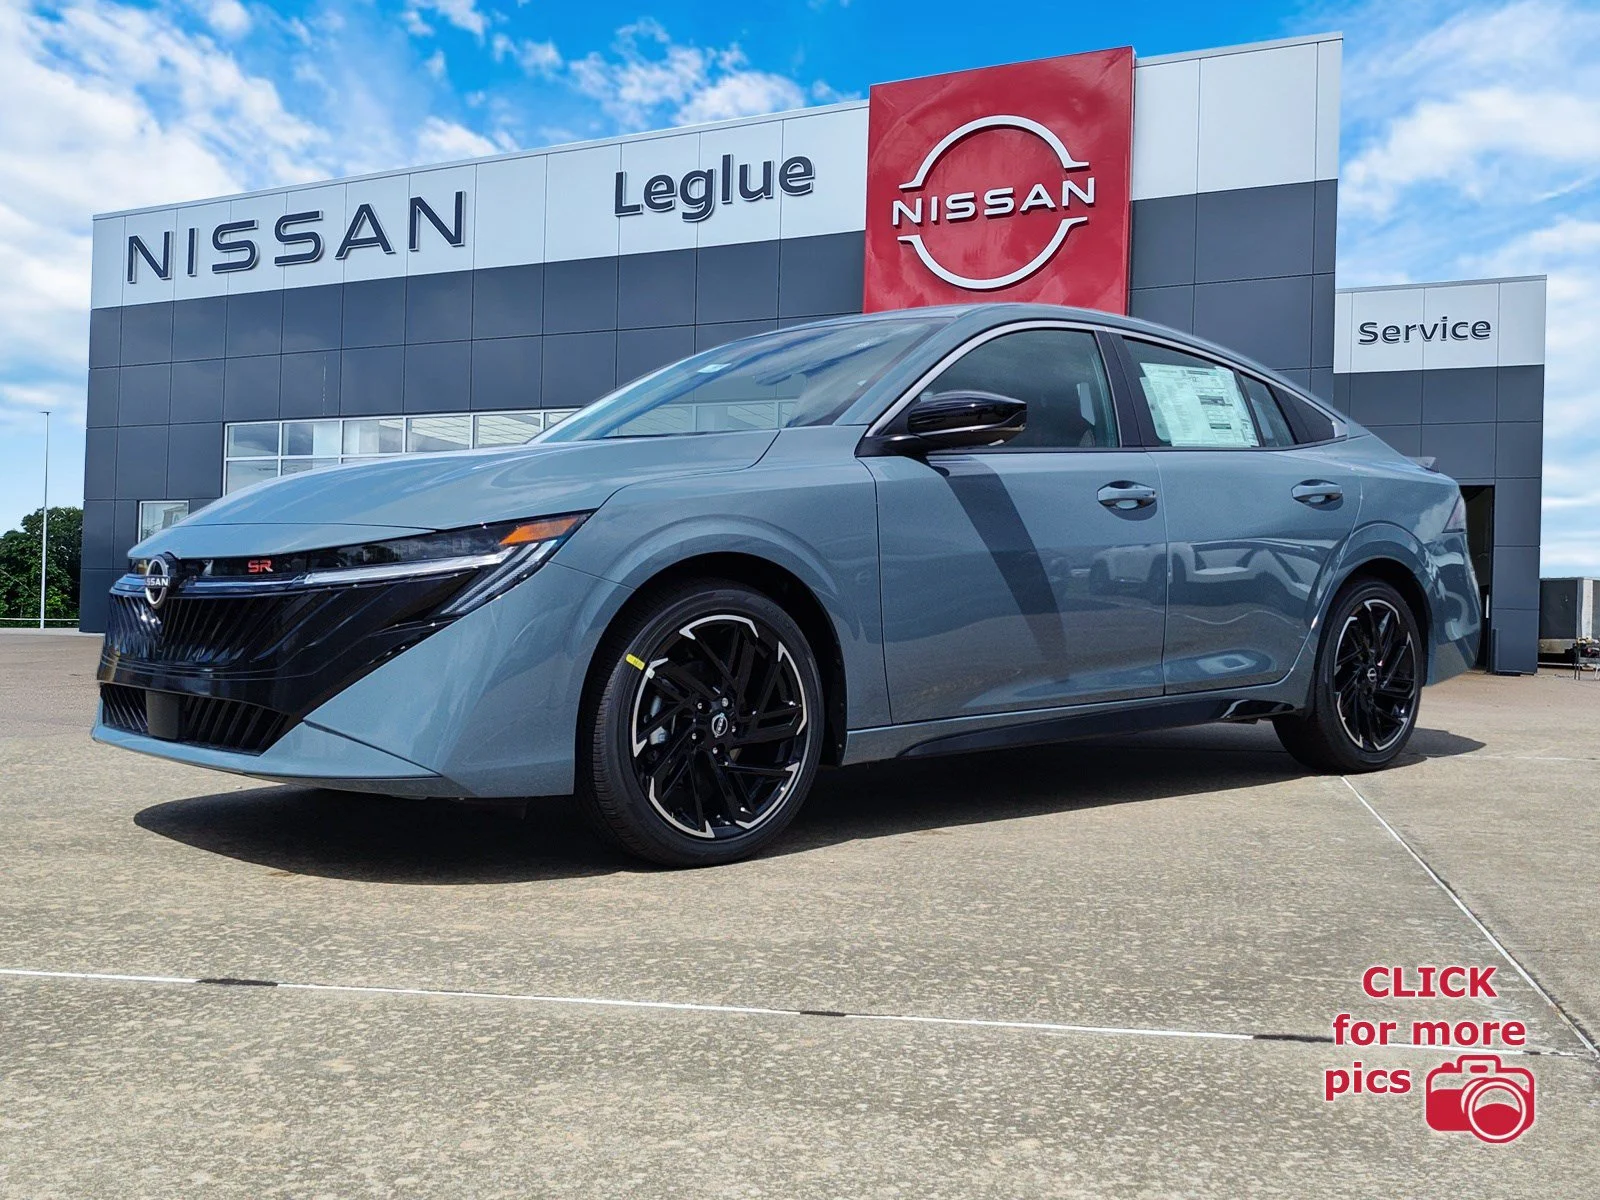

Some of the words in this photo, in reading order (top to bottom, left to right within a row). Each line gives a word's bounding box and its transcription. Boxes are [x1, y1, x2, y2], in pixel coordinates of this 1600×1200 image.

[614, 153, 816, 223] Leglue
[892, 177, 1096, 227] NISSAN
[127, 190, 466, 284] NISSAN
[1358, 316, 1492, 345] Service
[145, 576, 169, 587] SSAN
[247, 559, 274, 573] SR
